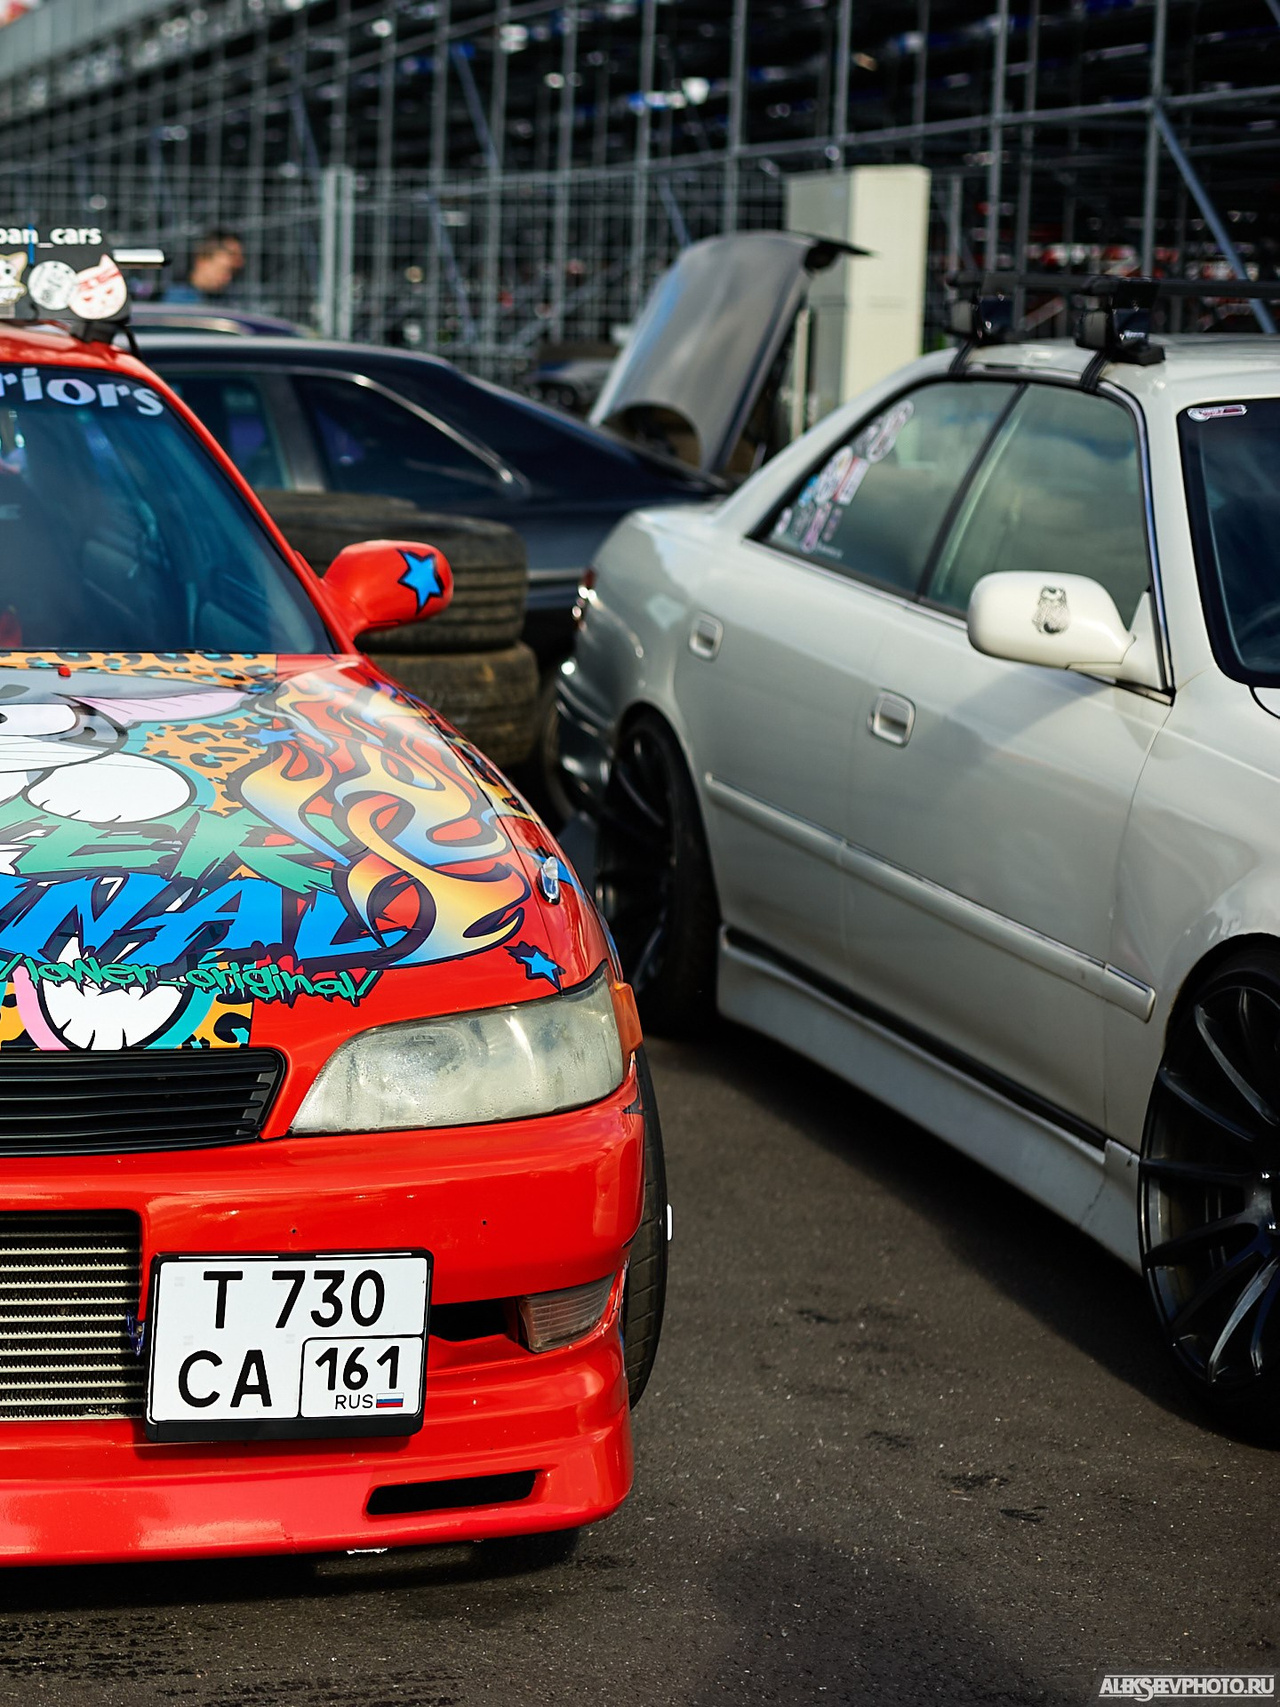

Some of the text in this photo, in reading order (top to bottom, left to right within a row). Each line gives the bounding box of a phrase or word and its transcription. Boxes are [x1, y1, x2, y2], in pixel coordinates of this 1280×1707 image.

[271, 1269, 385, 1329] 730
[315, 1345, 400, 1391] 161
[335, 1394, 373, 1409] RUS
